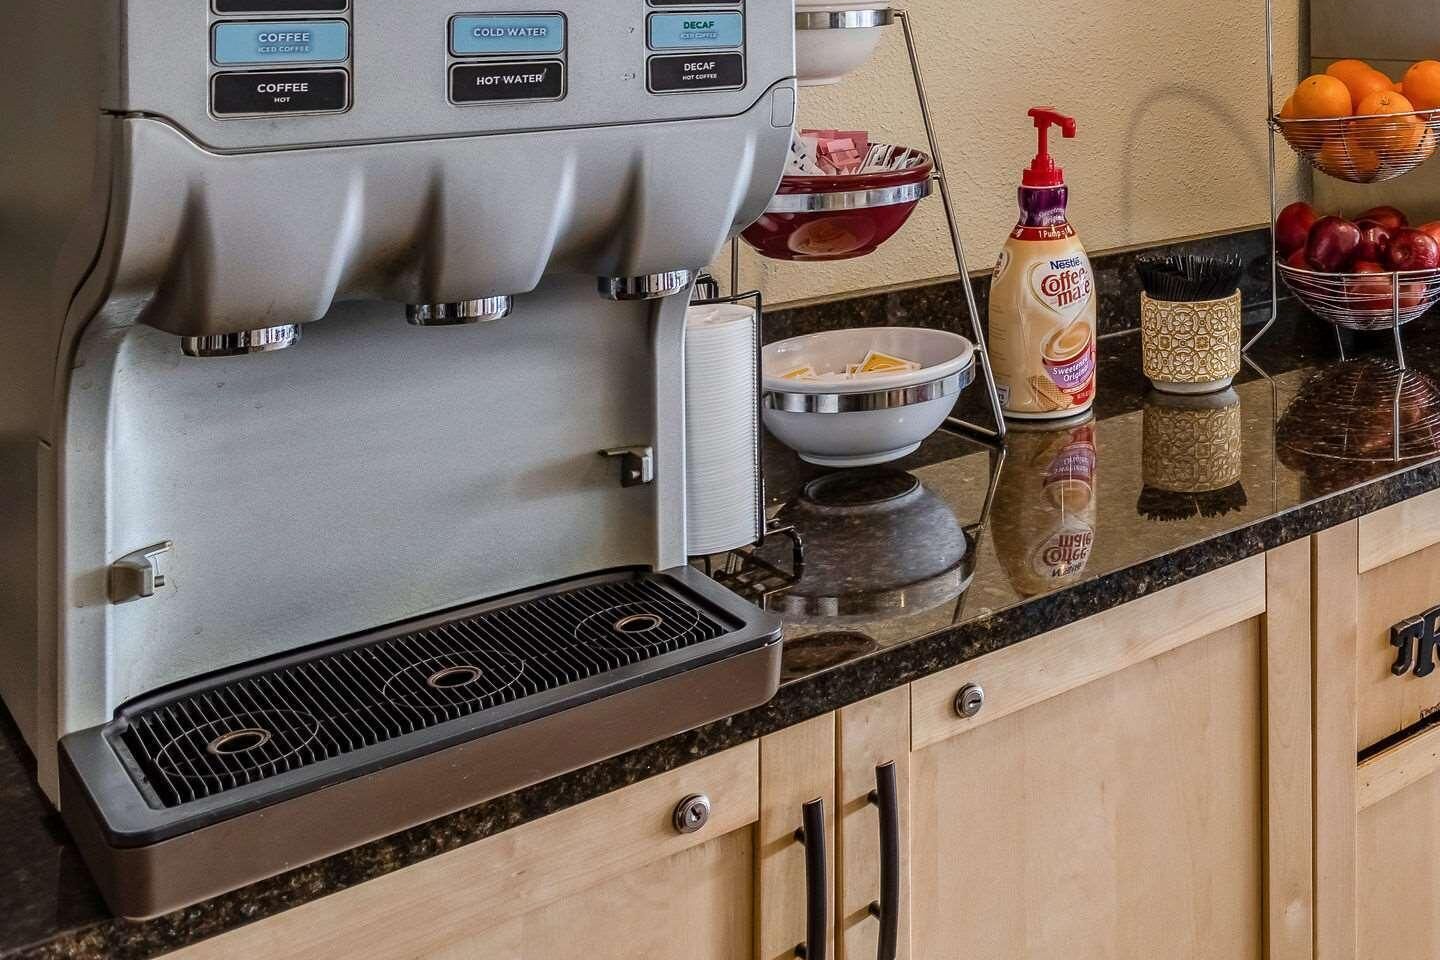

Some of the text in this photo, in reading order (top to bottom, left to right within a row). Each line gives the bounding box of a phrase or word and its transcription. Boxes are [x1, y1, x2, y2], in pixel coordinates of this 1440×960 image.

[683, 21, 715, 29] DECAF
[258, 32, 310, 42] COFFEE
[473, 27, 547, 37] COLD WATER
[279, 45, 310, 53] COFFEE
[683, 62, 716, 71] DECAF
[476, 74, 543, 85] HOT WATER
[257, 83, 309, 93] COFFEE
[1049, 257, 1081, 270] Nestlé
